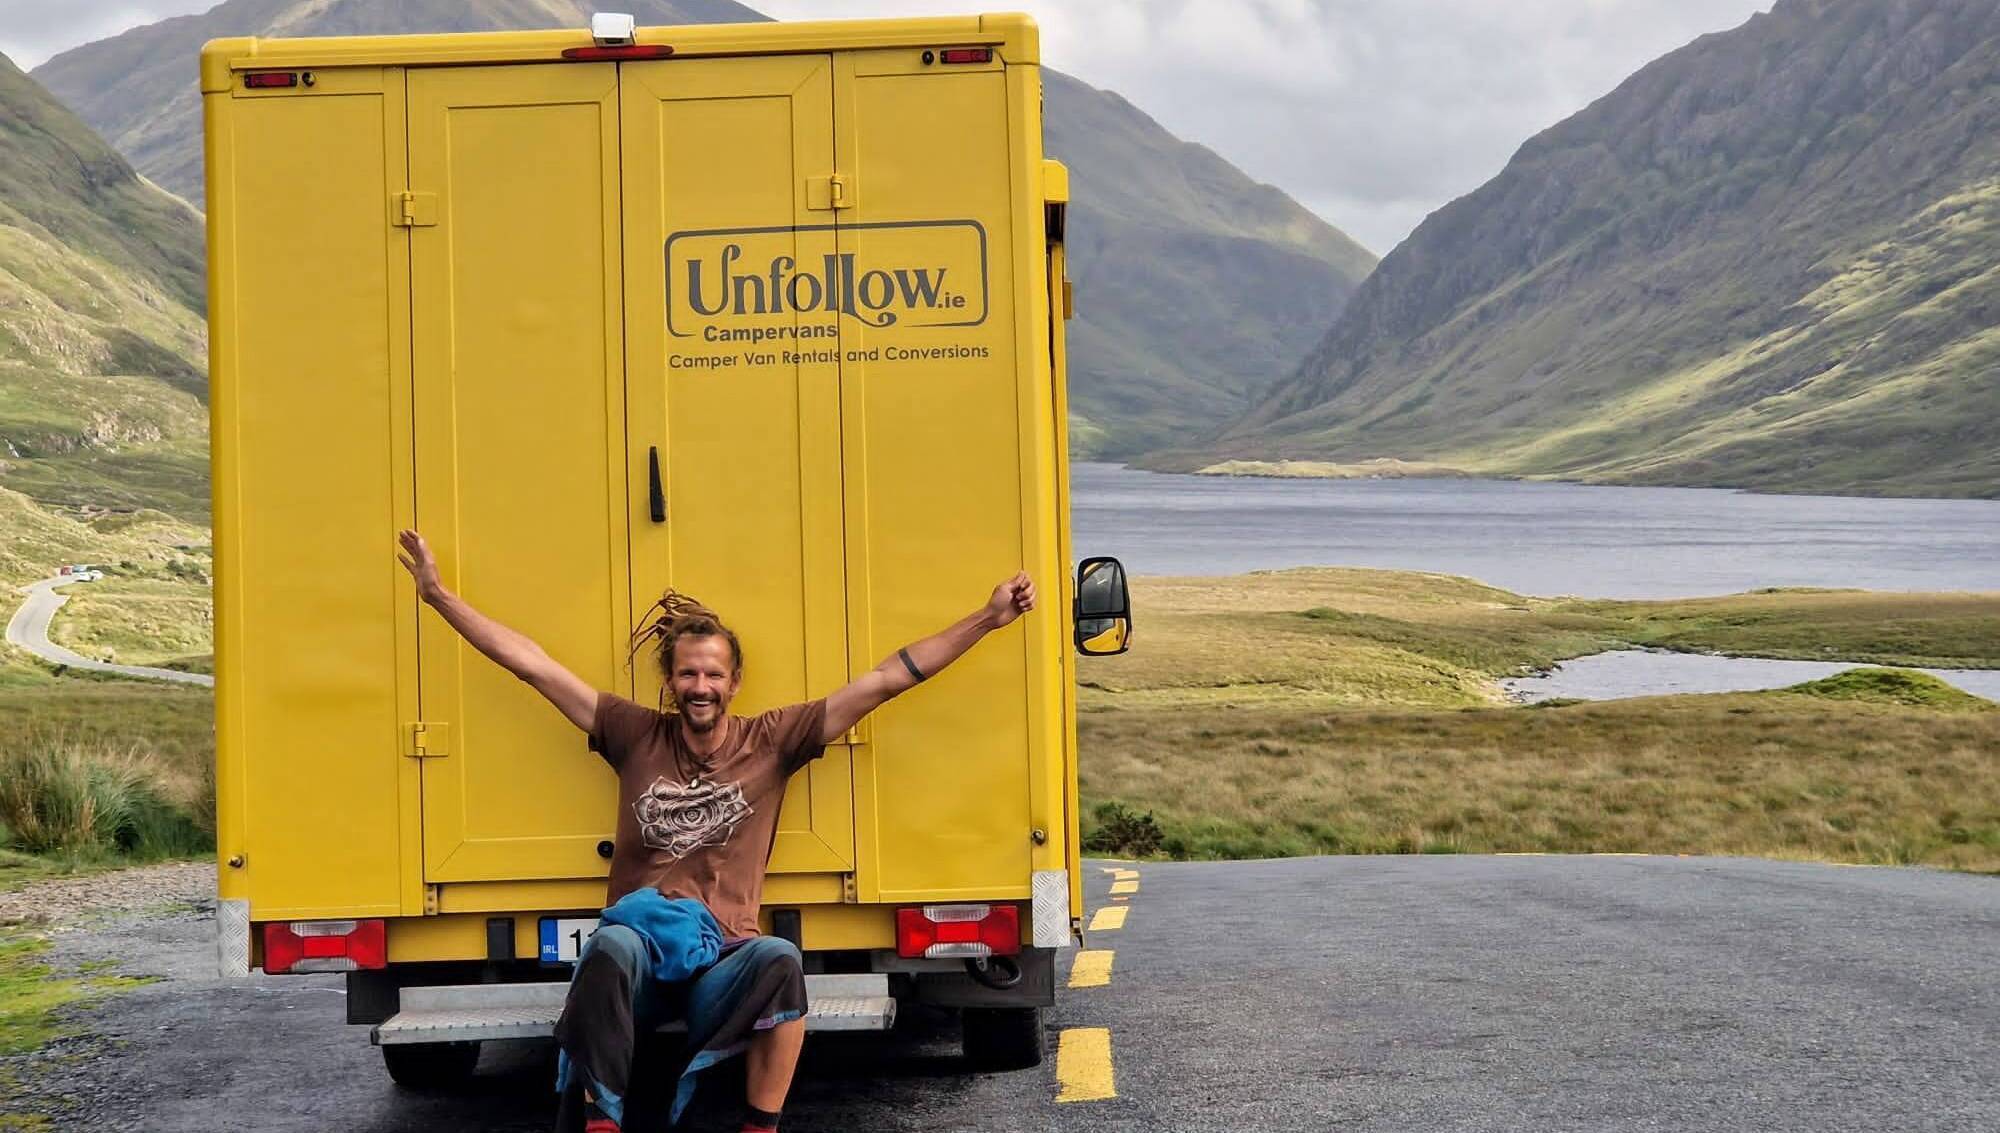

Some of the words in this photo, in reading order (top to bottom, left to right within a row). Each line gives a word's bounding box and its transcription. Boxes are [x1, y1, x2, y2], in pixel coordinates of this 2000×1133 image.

[703, 324, 838, 345] Campervans
[669, 354, 738, 370] Camper
[744, 352, 776, 366] Van
[782, 348, 841, 364] Rentals
[847, 346, 879, 362] and
[885, 344, 989, 361] Conversions
[543, 944, 558, 954] IRL
